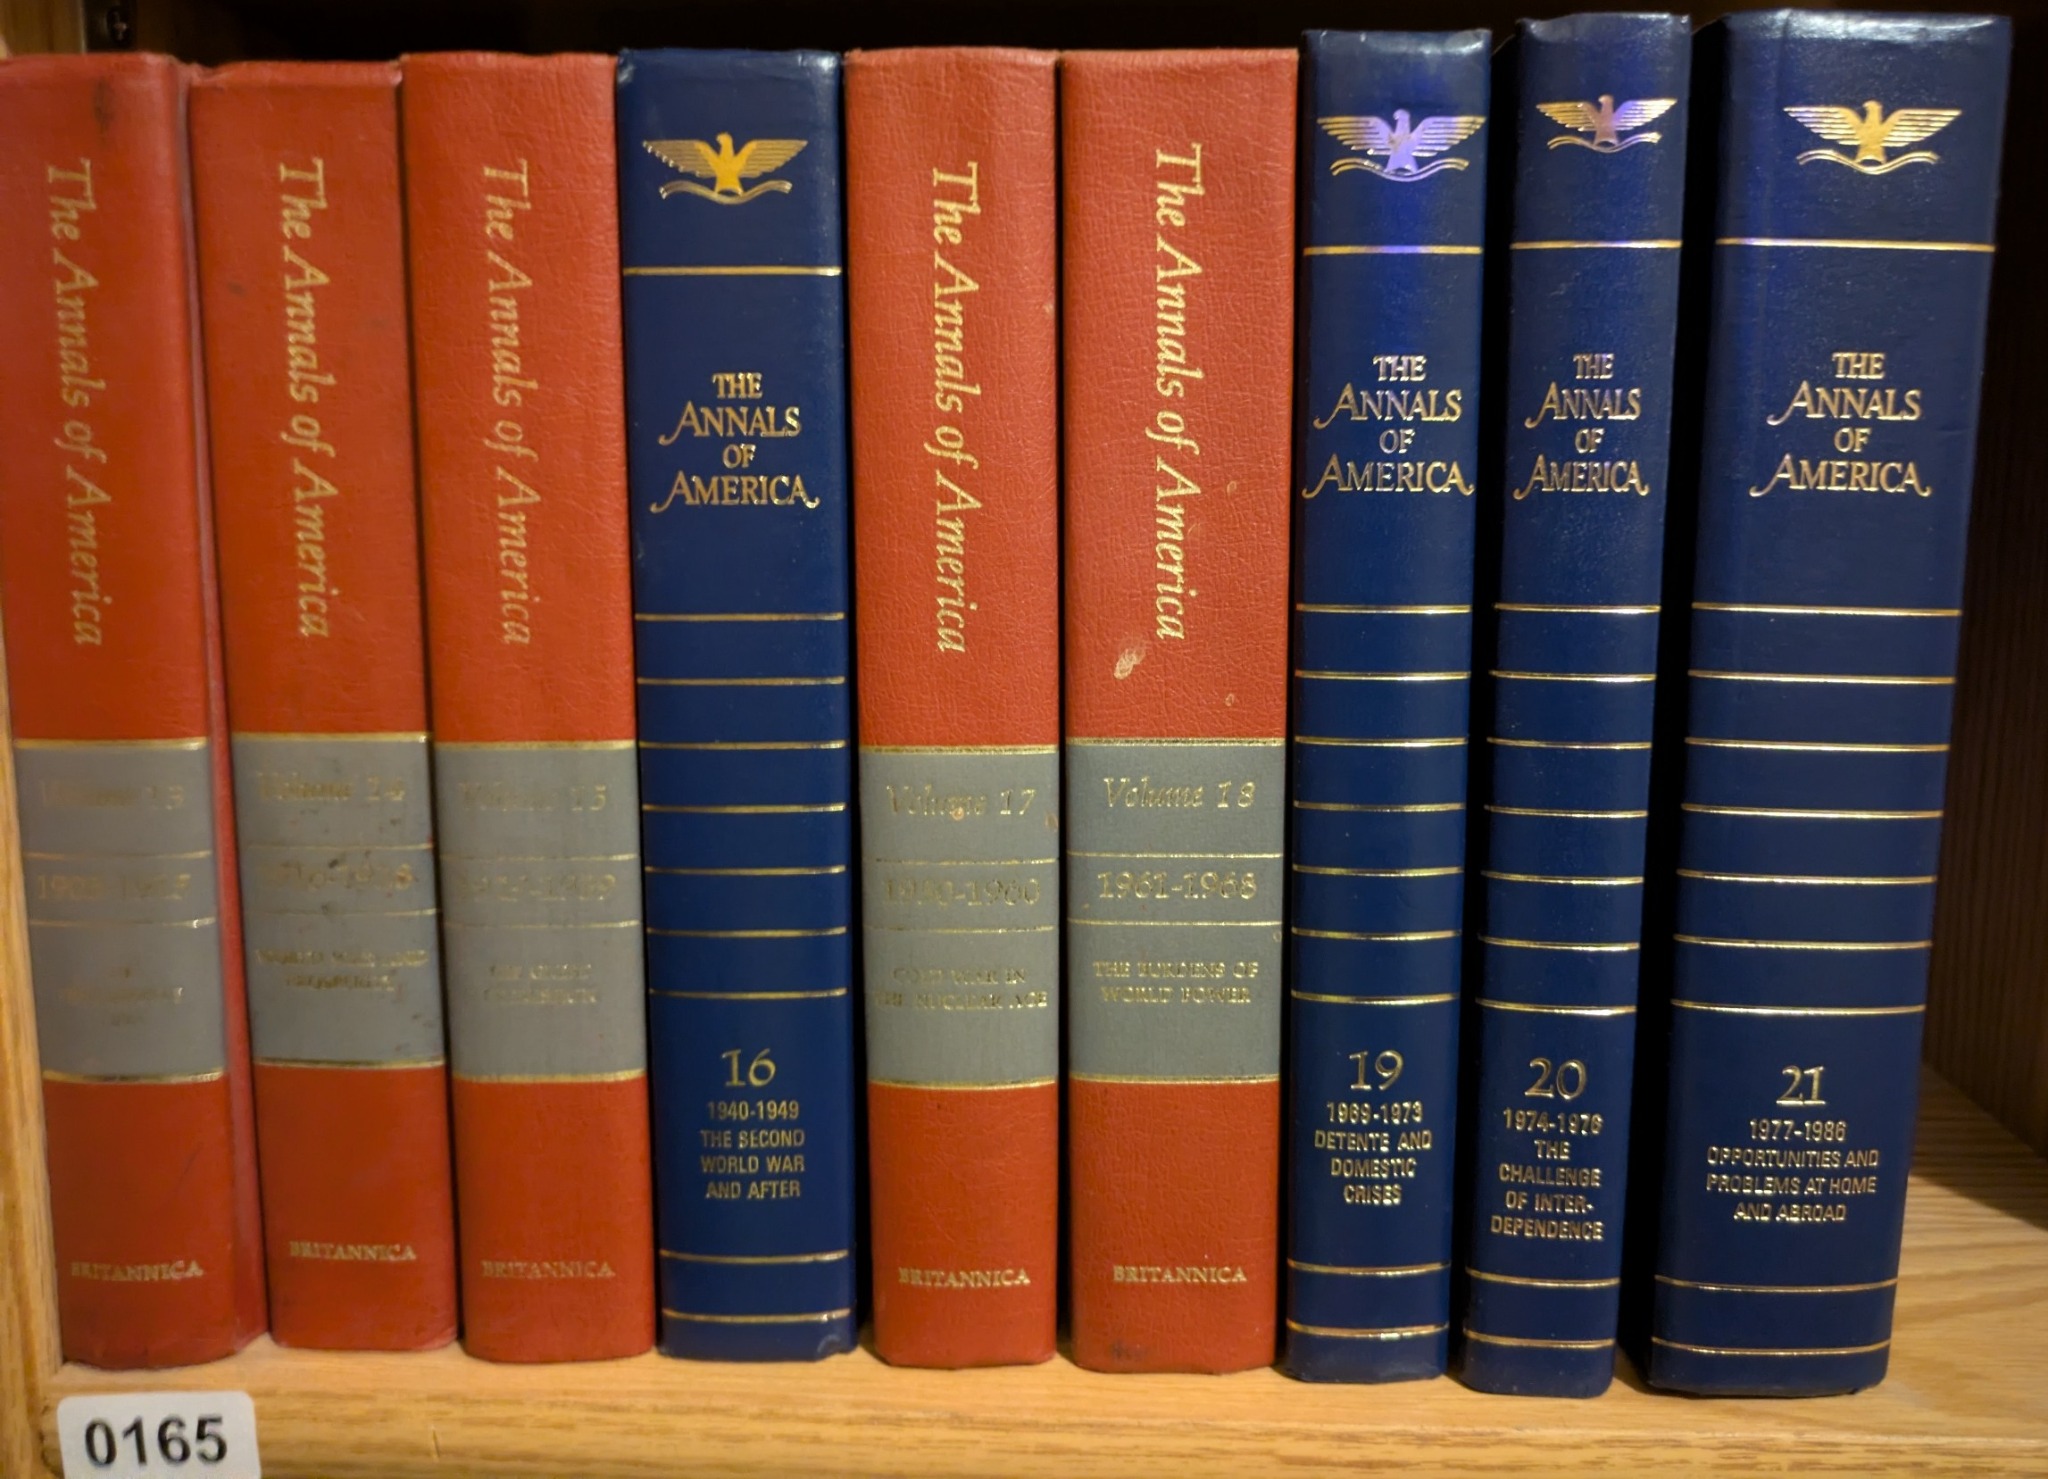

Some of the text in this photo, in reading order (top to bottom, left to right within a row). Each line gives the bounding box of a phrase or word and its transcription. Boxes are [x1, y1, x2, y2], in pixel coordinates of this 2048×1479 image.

[1372, 354, 1427, 382] THE
[1573, 353, 1615, 380] THE
[1831, 352, 1886, 379] THE
[279, 157, 340, 639] The Annals of America
[712, 372, 763, 399] THE
[1145, 142, 1206, 641] The Annals of America
[48, 158, 113, 646] The Annals of America
[483, 158, 542, 646] The Annals of America
[923, 161, 983, 653] The Annals of America
[1313, 382, 1463, 430] ANNALS
[1524, 381, 1642, 429] ANNALS
[1766, 380, 1922, 426] ANNALS
[658, 400, 802, 446] ANNALS
[1379, 429, 1416, 454] OF
[1575, 428, 1605, 454] OF
[1834, 427, 1871, 453] OF
[722, 444, 756, 468] OF
[1302, 453, 1475, 499] AMERICA
[1513, 454, 1649, 500] AMERICA
[1749, 453, 1932, 497] AMERICA
[650, 470, 820, 513] AMERICA
[1000, 789, 1036, 815] 17
[1103, 776, 1257, 808] Volume 18
[1097, 871, 1258, 900] 1961-1968
[1005, 968, 1027, 984] IN
[1093, 961, 1259, 978] THE BURDENS OF
[1100, 986, 1251, 1004] WORLD POWER
[721, 1048, 777, 1087] 16
[1349, 1049, 1404, 1091] 19
[1524, 1057, 1588, 1100] 20
[1776, 1065, 1826, 1106] 21
[708, 1100, 801, 1121] 1940-1949
[1326, 1101, 1423, 1125] 1969-1973
[1503, 1107, 1603, 1136] 1974-1976
[699, 1128, 805, 1148] THE SECOND
[1314, 1129, 1433, 1152] DETENTE AND
[1750, 1118, 1847, 1142] 1977-1986
[1534, 1139, 1571, 1160] THE
[1707, 1146, 1880, 1168] OPPORTUNITIES AND
[700, 1154, 805, 1174] WORLD WAR
[1331, 1157, 1417, 1178] DOMESTIC
[1499, 1163, 1602, 1187] CHALLENGE
[705, 1180, 801, 1199] AND AFTER
[1344, 1184, 1402, 1206] CRISES
[1706, 1173, 1877, 1195] PROBLEMS AT HOME
[1505, 1190, 1594, 1214] OF INTER-
[1733, 1202, 1847, 1222] AND ABROAD
[1490, 1215, 1604, 1241] DEPENDENCE
[289, 1241, 417, 1262] BRITANNICA
[71, 1259, 204, 1281] BRITANNICA
[481, 1260, 616, 1279] BRITANNICA
[899, 1266, 1031, 1288] BRITANNICA
[1112, 1264, 1247, 1283] BRITANNICA
[84, 1413, 228, 1469] 0165
